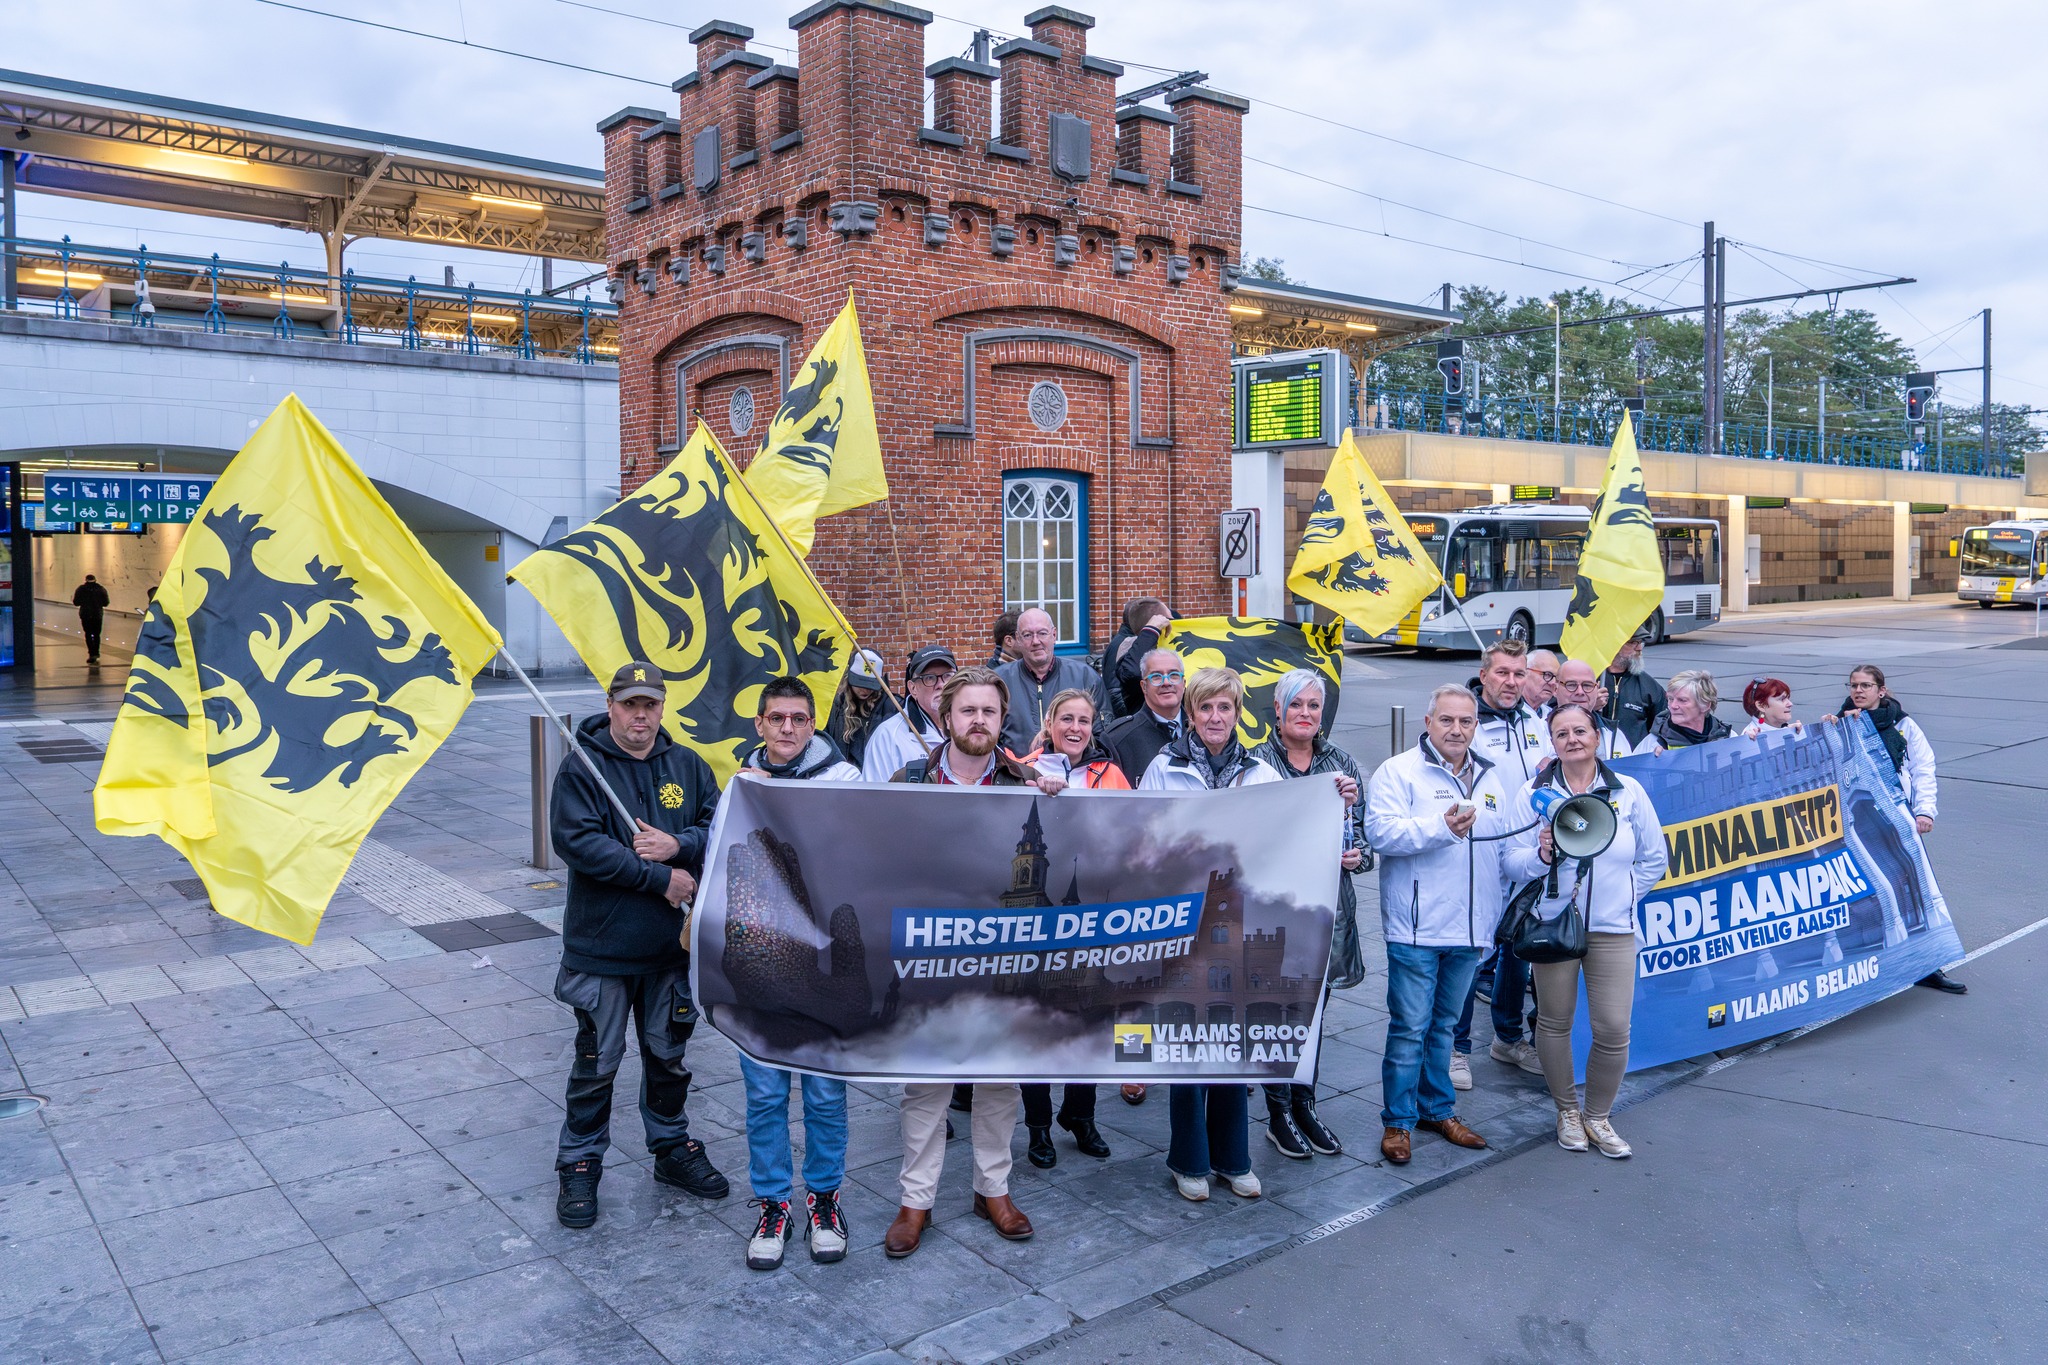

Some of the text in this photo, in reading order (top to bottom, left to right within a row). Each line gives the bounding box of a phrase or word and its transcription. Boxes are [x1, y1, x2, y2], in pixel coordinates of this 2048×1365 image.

[1247, 346, 1266, 356] AALST
[1227, 517, 1246, 526] ZONE
[1411, 522, 1435, 533] Dienst
[1637, 851, 1868, 948] RDE AANPAK!
[905, 901, 1191, 948] HERSTEL DE ORDE
[1643, 909, 1849, 974] VOOR EEN VEILIG AALST!
[894, 936, 1195, 979] VEILIGHEID IS PRIORITEIT
[1731, 956, 1880, 1023] VLAAMS BELANG
[1153, 1023, 1311, 1043] VLAAMS GROO
[1153, 1044, 1242, 1063] BELANG
